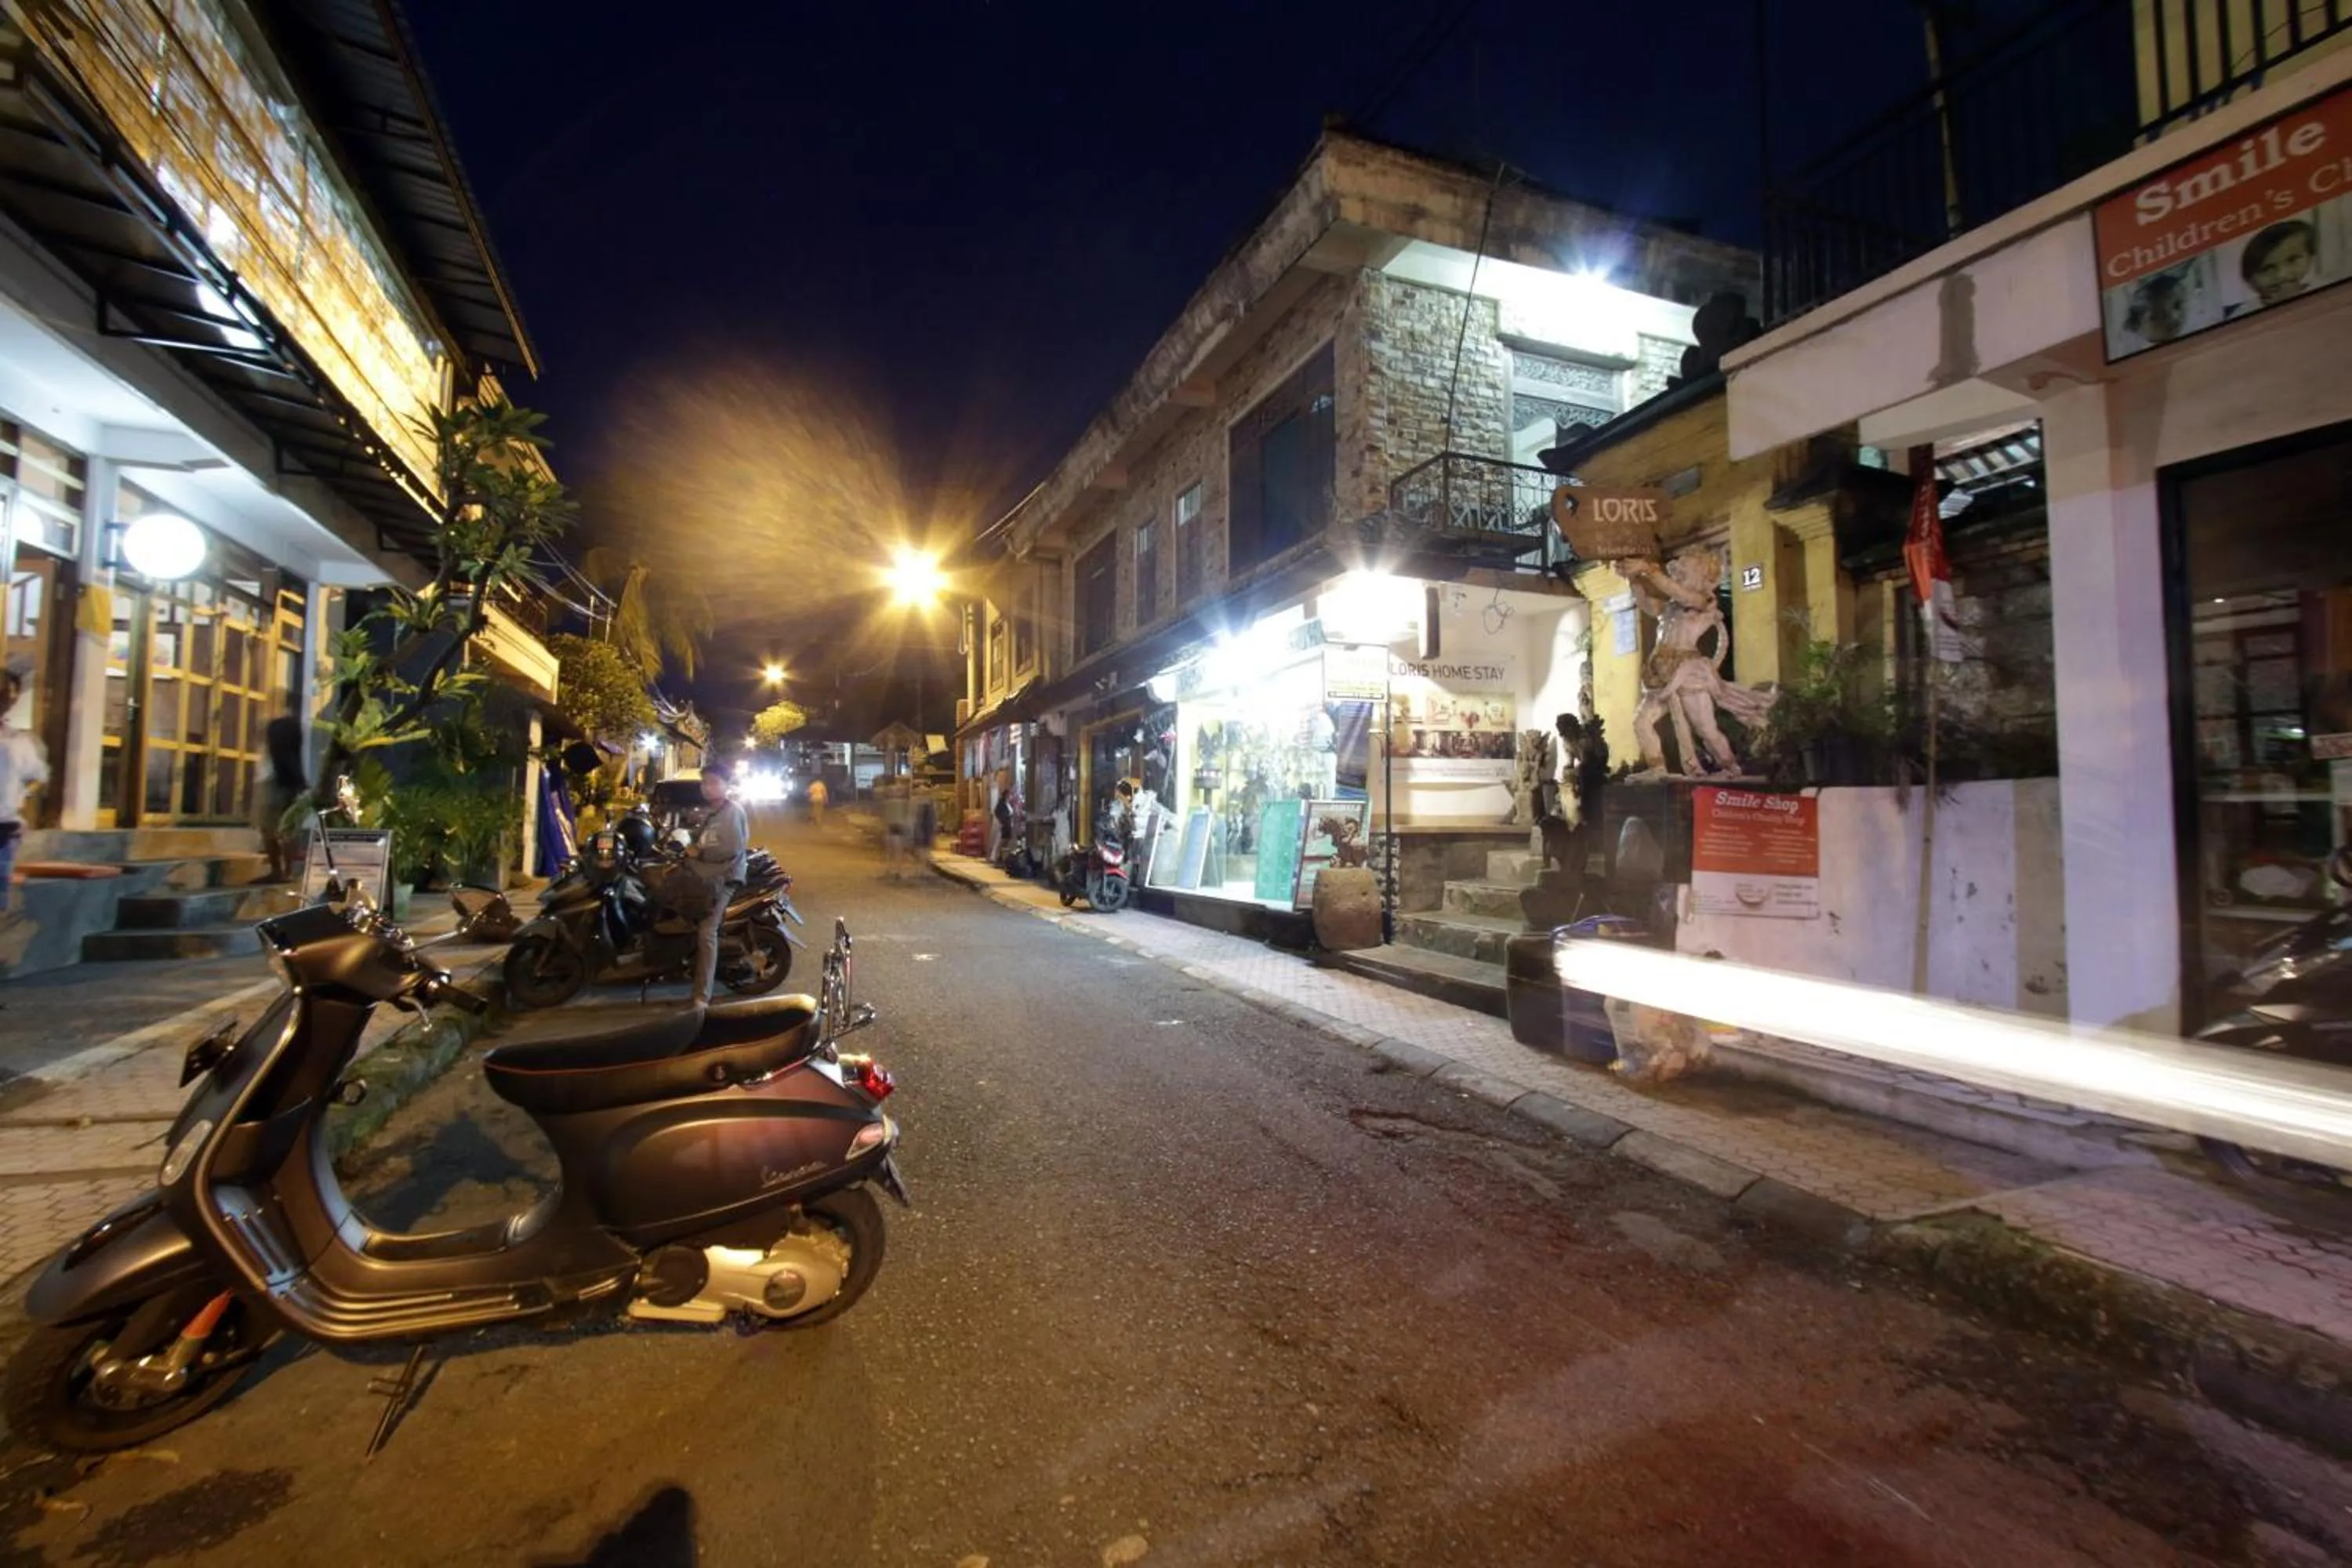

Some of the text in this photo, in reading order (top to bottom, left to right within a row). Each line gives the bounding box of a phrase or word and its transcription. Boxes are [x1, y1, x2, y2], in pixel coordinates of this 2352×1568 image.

[2136, 122, 2326, 227] Smile
[2107, 189, 2294, 278] Children's
[1592, 498, 1657, 524] LORIS
[1743, 568, 1760, 586] 12
[1390, 663, 1430, 677] LORIS
[1715, 791, 1799, 814] Smile Shop
